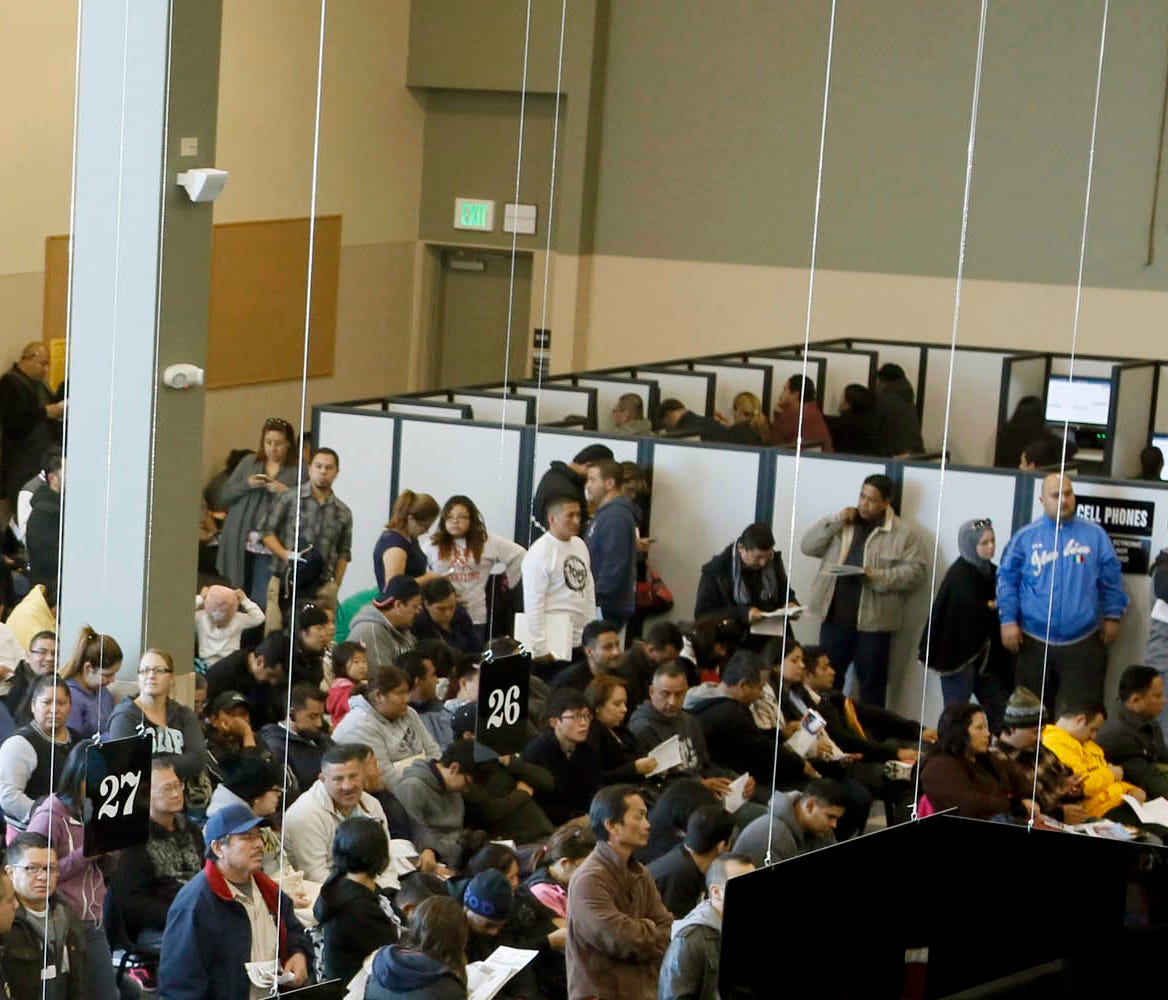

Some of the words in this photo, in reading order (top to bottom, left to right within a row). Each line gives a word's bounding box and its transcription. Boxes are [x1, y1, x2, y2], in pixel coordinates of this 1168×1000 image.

[461, 203, 488, 226] EXIT
[1076, 504, 1102, 523] CELL
[1105, 506, 1148, 528] PHONES
[486, 685, 520, 729] 26
[97, 770, 142, 820] 27
